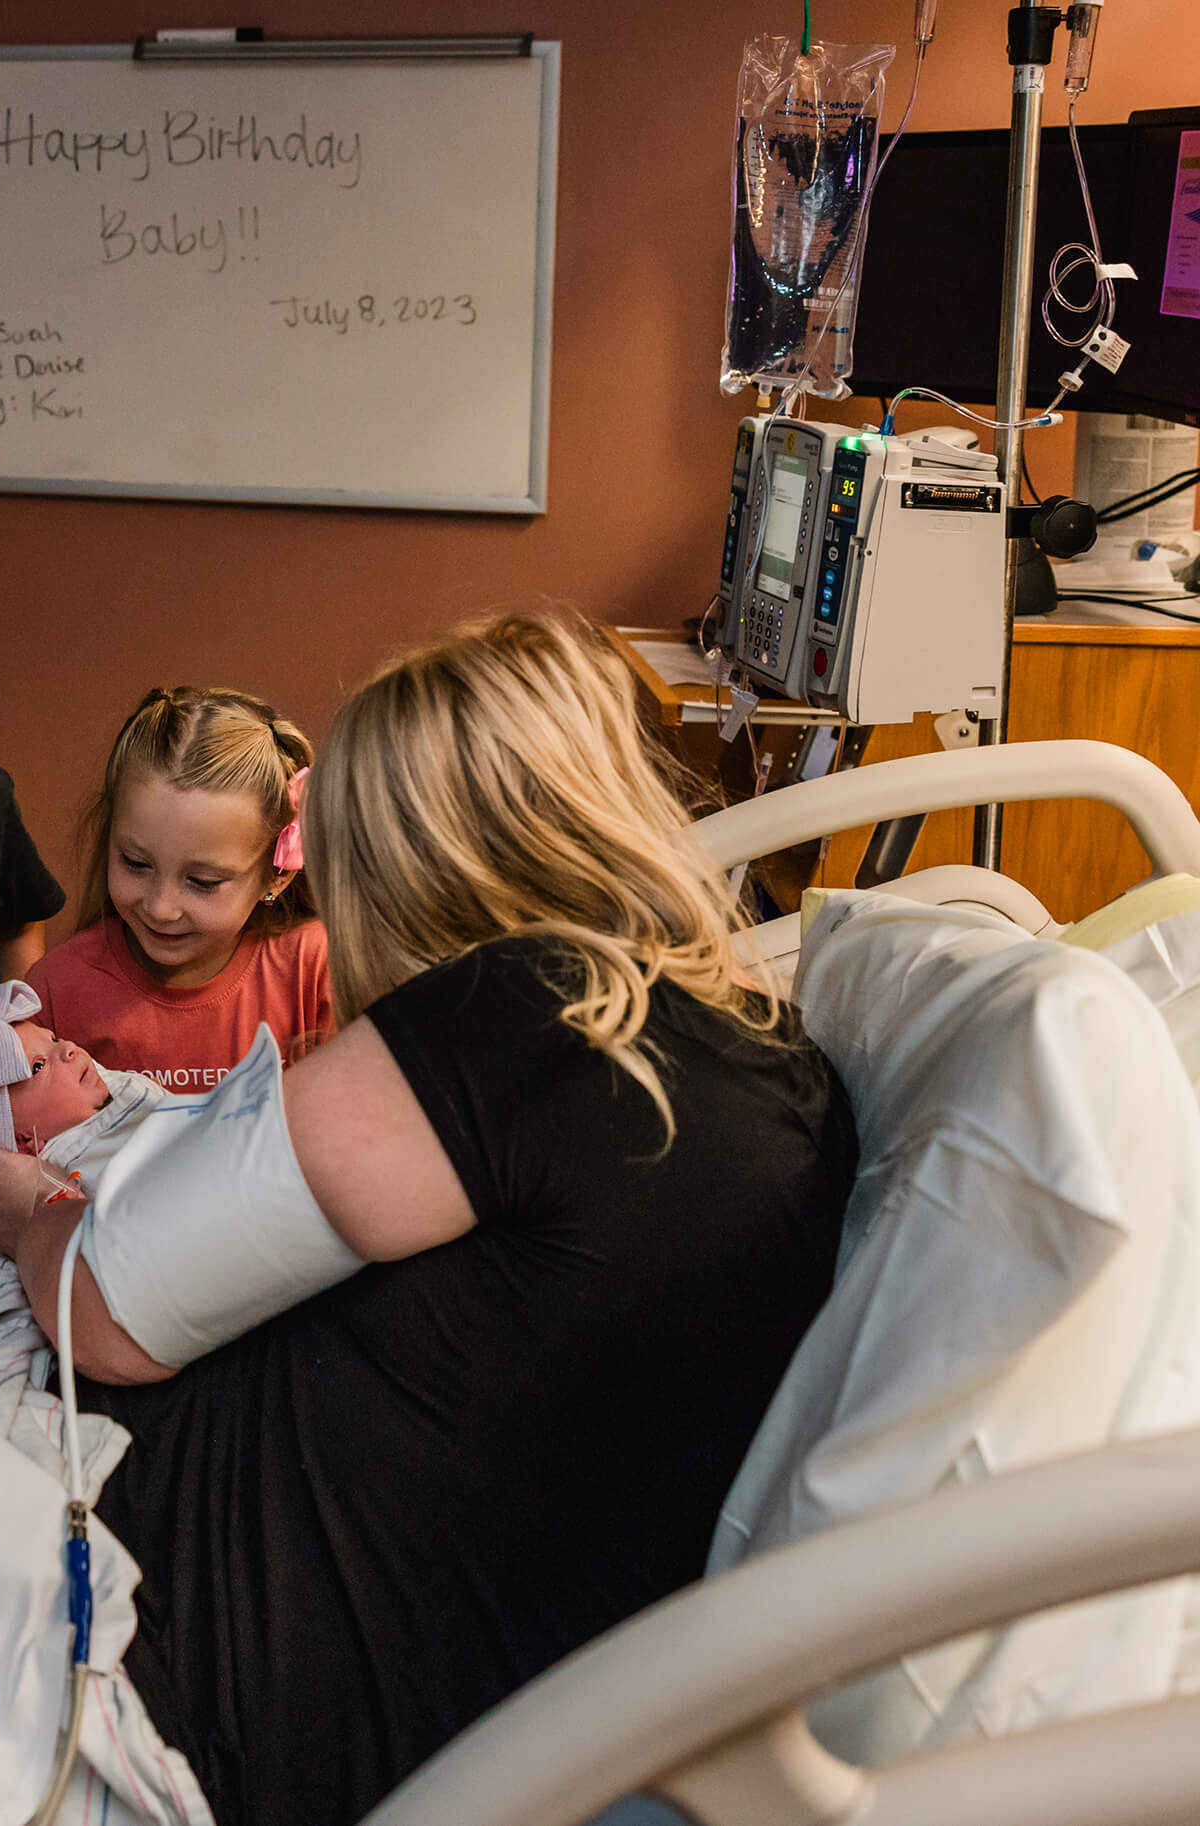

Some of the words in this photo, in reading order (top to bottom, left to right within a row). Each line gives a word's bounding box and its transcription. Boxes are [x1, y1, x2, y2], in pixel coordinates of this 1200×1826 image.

[163, 108, 363, 188] Birthday
[99, 204, 261, 273] Baby!!
[271, 296, 351, 334] July
[356, 294, 387, 330] 8,
[394, 294, 478, 327] 2023
[841, 479, 856, 497] 95
[127, 1068, 230, 1087] OMOTED
